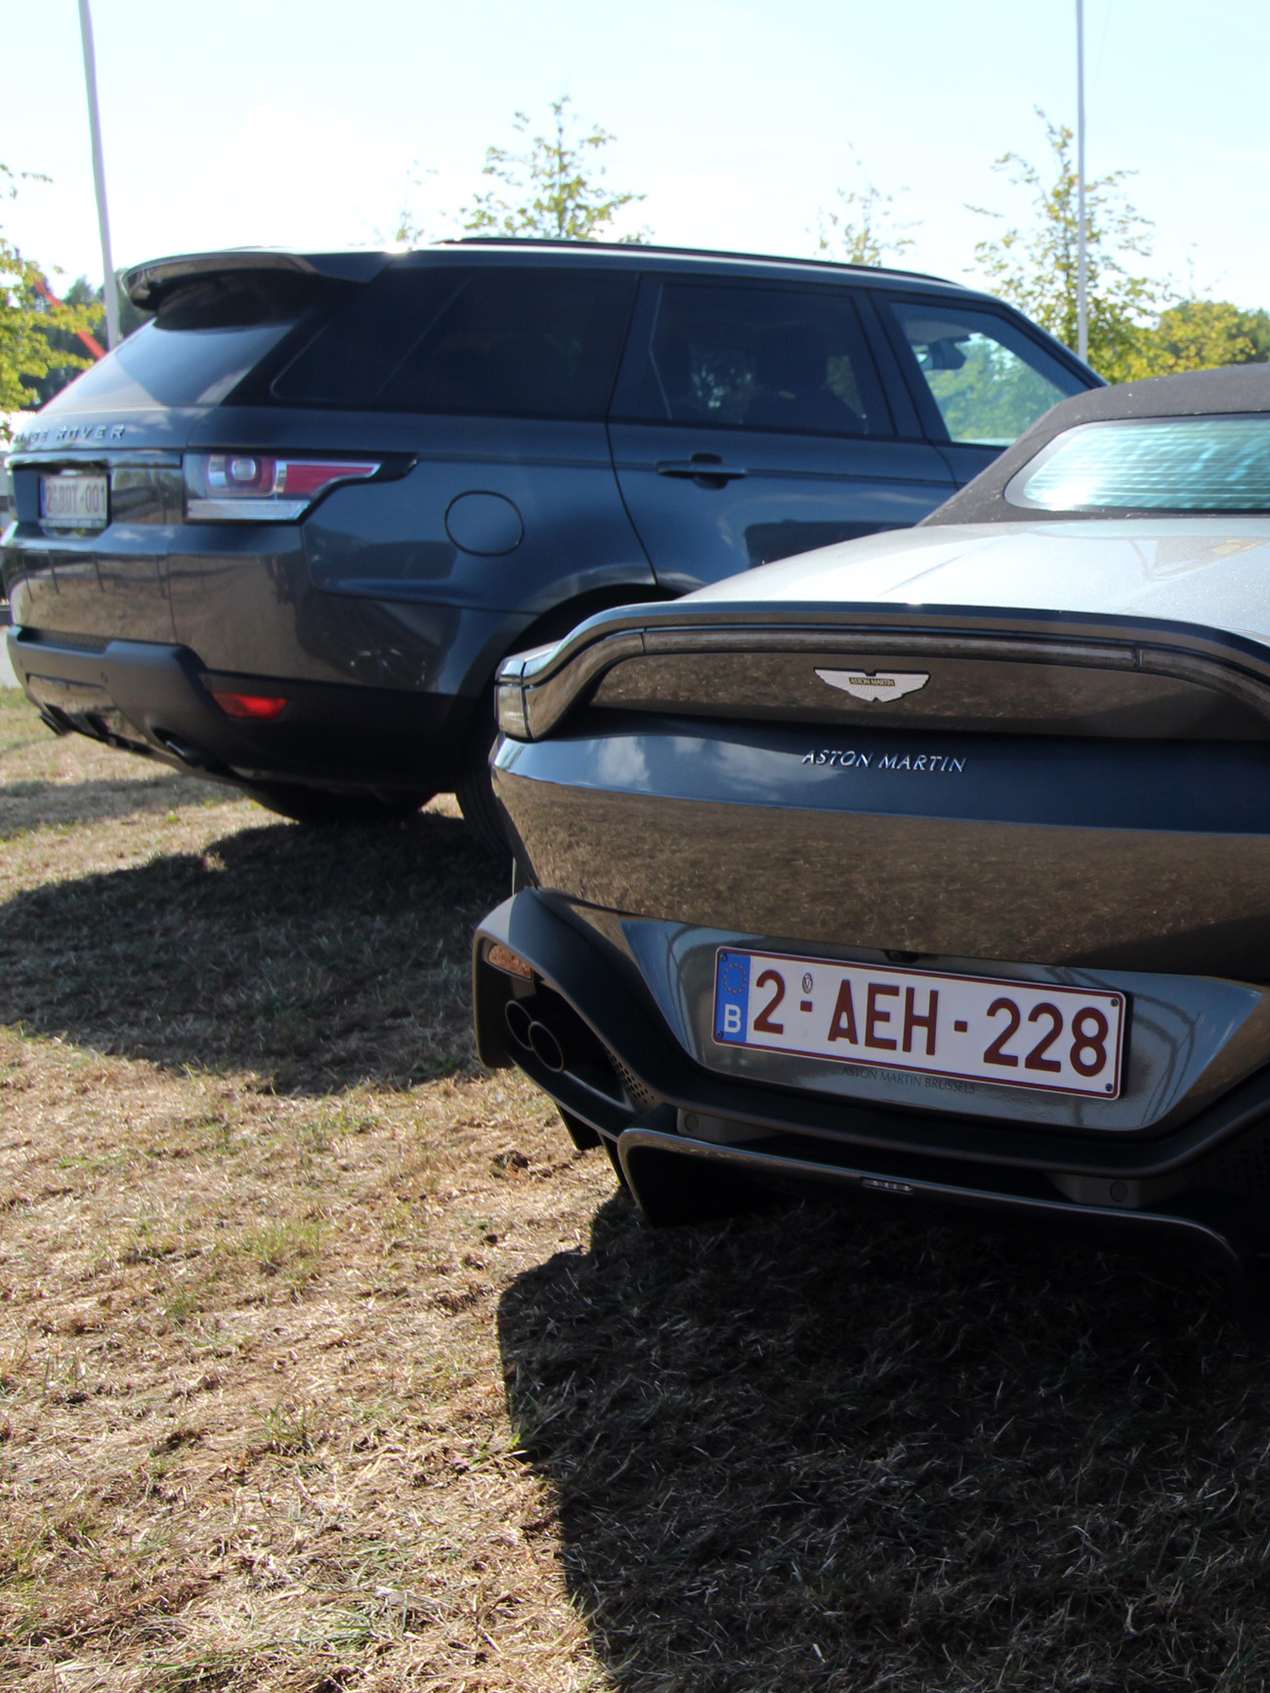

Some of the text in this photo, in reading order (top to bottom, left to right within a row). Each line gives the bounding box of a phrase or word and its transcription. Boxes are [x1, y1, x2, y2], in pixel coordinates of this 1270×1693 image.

[56, 423, 125, 441] ROVER
[850, 677, 870, 685] ASTON
[801, 749, 967, 773] ASTON MARTIN
[723, 1004, 742, 1033] B
[842, 1066, 976, 1094] ASTON MARTIN BRUSSELS
